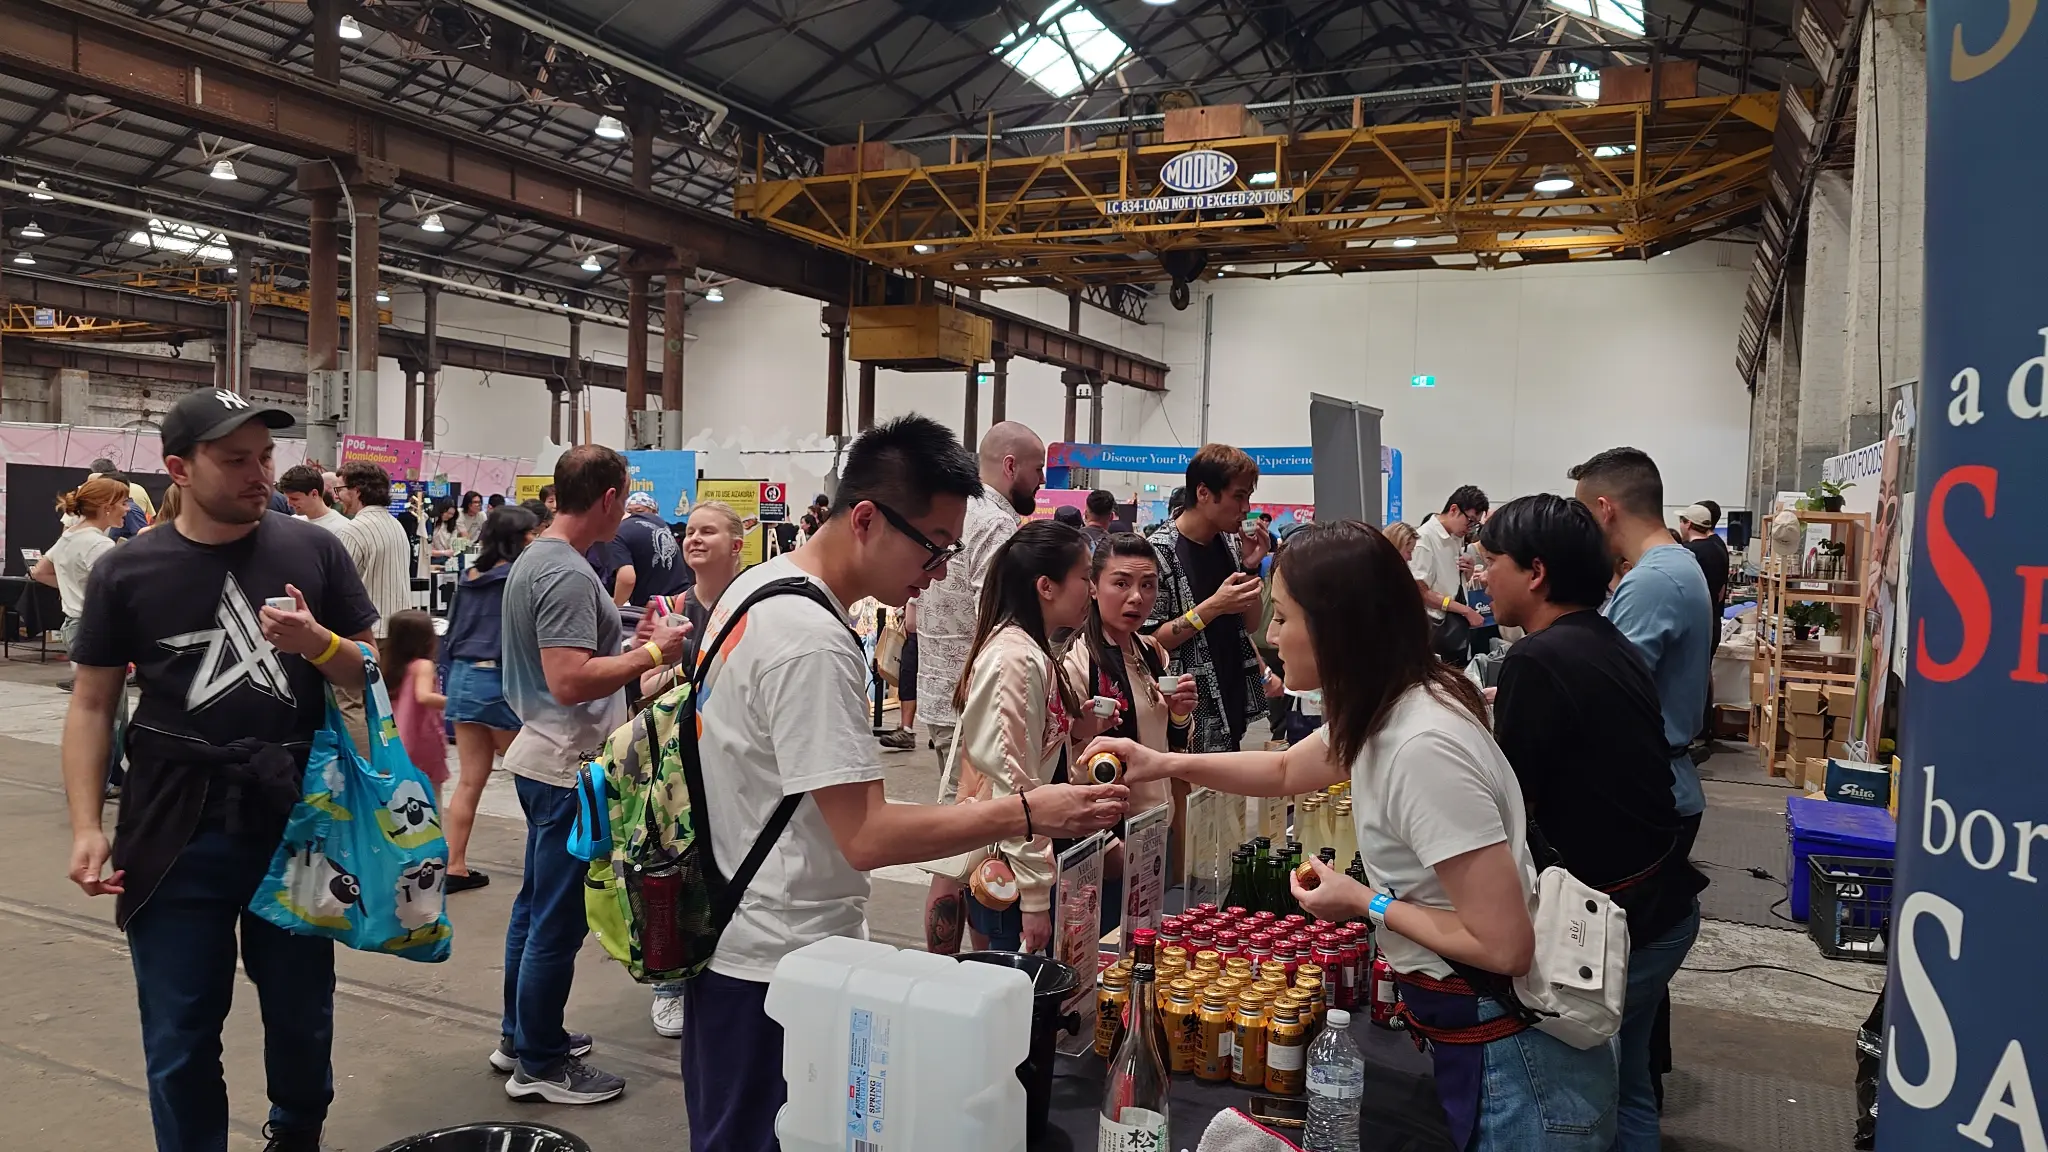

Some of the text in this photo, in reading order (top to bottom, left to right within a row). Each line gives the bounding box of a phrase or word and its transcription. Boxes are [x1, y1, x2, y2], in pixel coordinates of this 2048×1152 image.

[1166, 152, 1232, 189] MOORE
[1107, 202, 1121, 214] LC
[1171, 196, 1189, 210] NOT
[1189, 195, 1204, 209] TO
[1263, 189, 1290, 203] TONS
[346, 438, 366, 450] P06
[344, 450, 397, 464] Nomidokoro
[1101, 451, 1147, 464] Discover
[1150, 453, 1174, 465] Your
[1857, 443, 1883, 478] FOODS
[704, 490, 714, 498] HOW
[868, 1080, 876, 1114] SPRING
